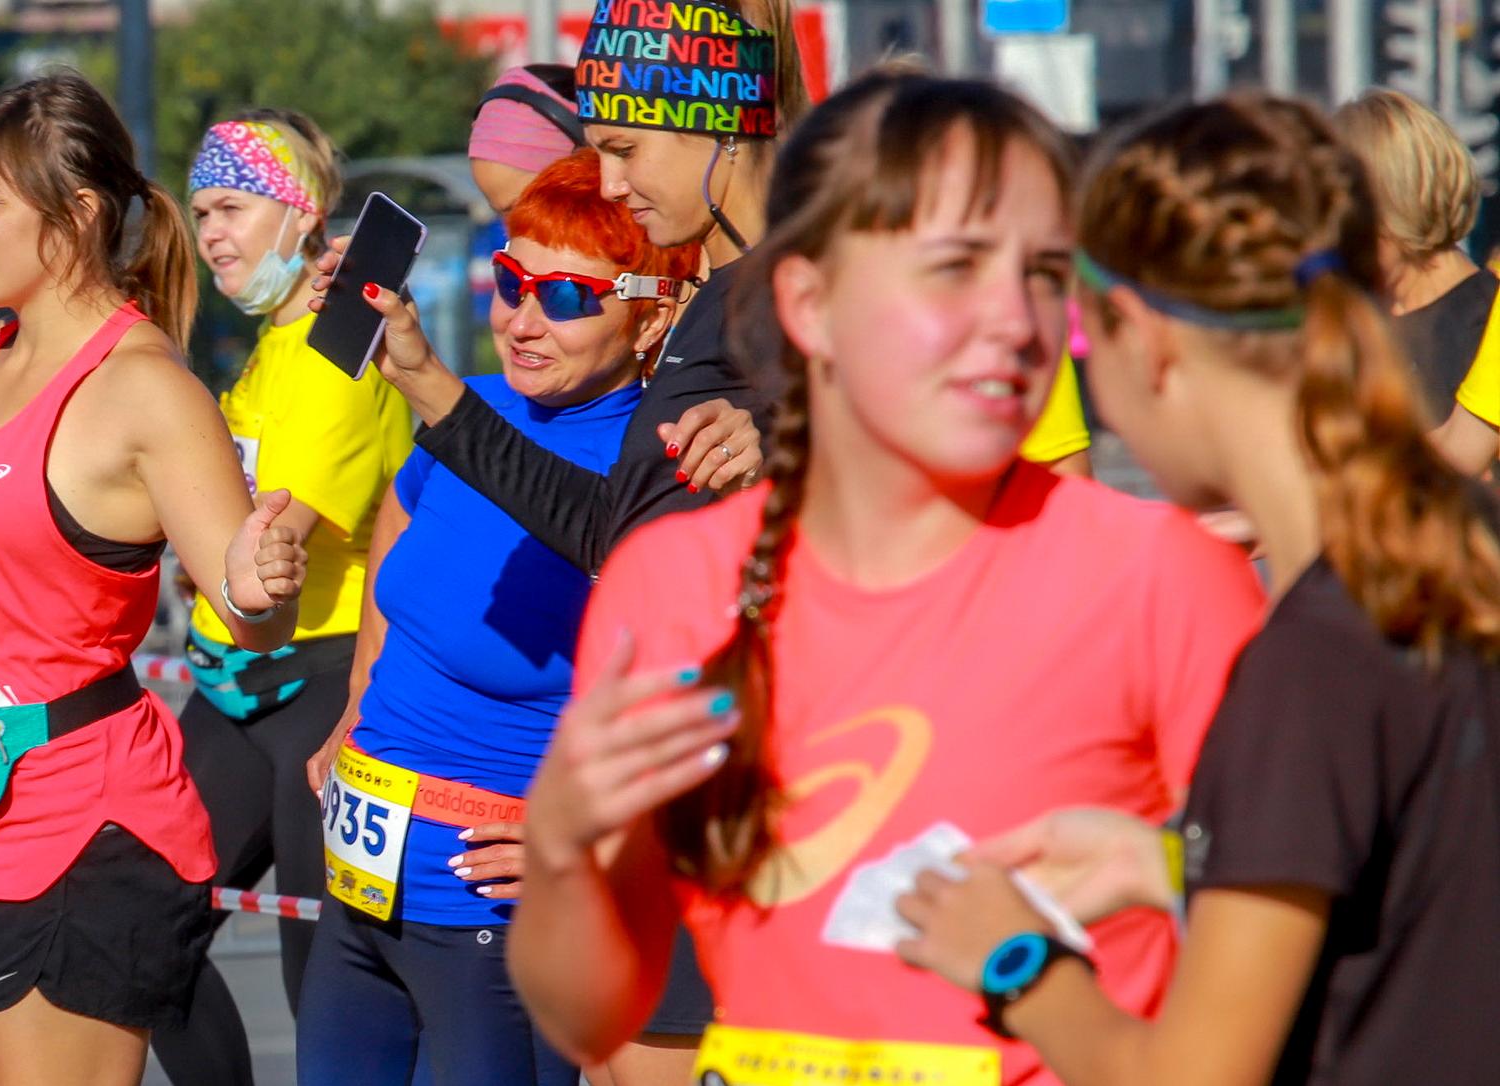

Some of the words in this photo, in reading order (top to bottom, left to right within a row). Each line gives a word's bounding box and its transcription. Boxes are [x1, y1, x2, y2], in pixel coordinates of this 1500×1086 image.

[594, 28, 669, 60] RUN
[667, 34, 739, 68] RUN
[620, 62, 695, 96] RUN
[692, 68, 761, 101] RUN
[592, 91, 665, 125] RUN
[660, 99, 740, 132] RUN
[423, 787, 486, 818] adidas
[490, 803, 524, 822] run
